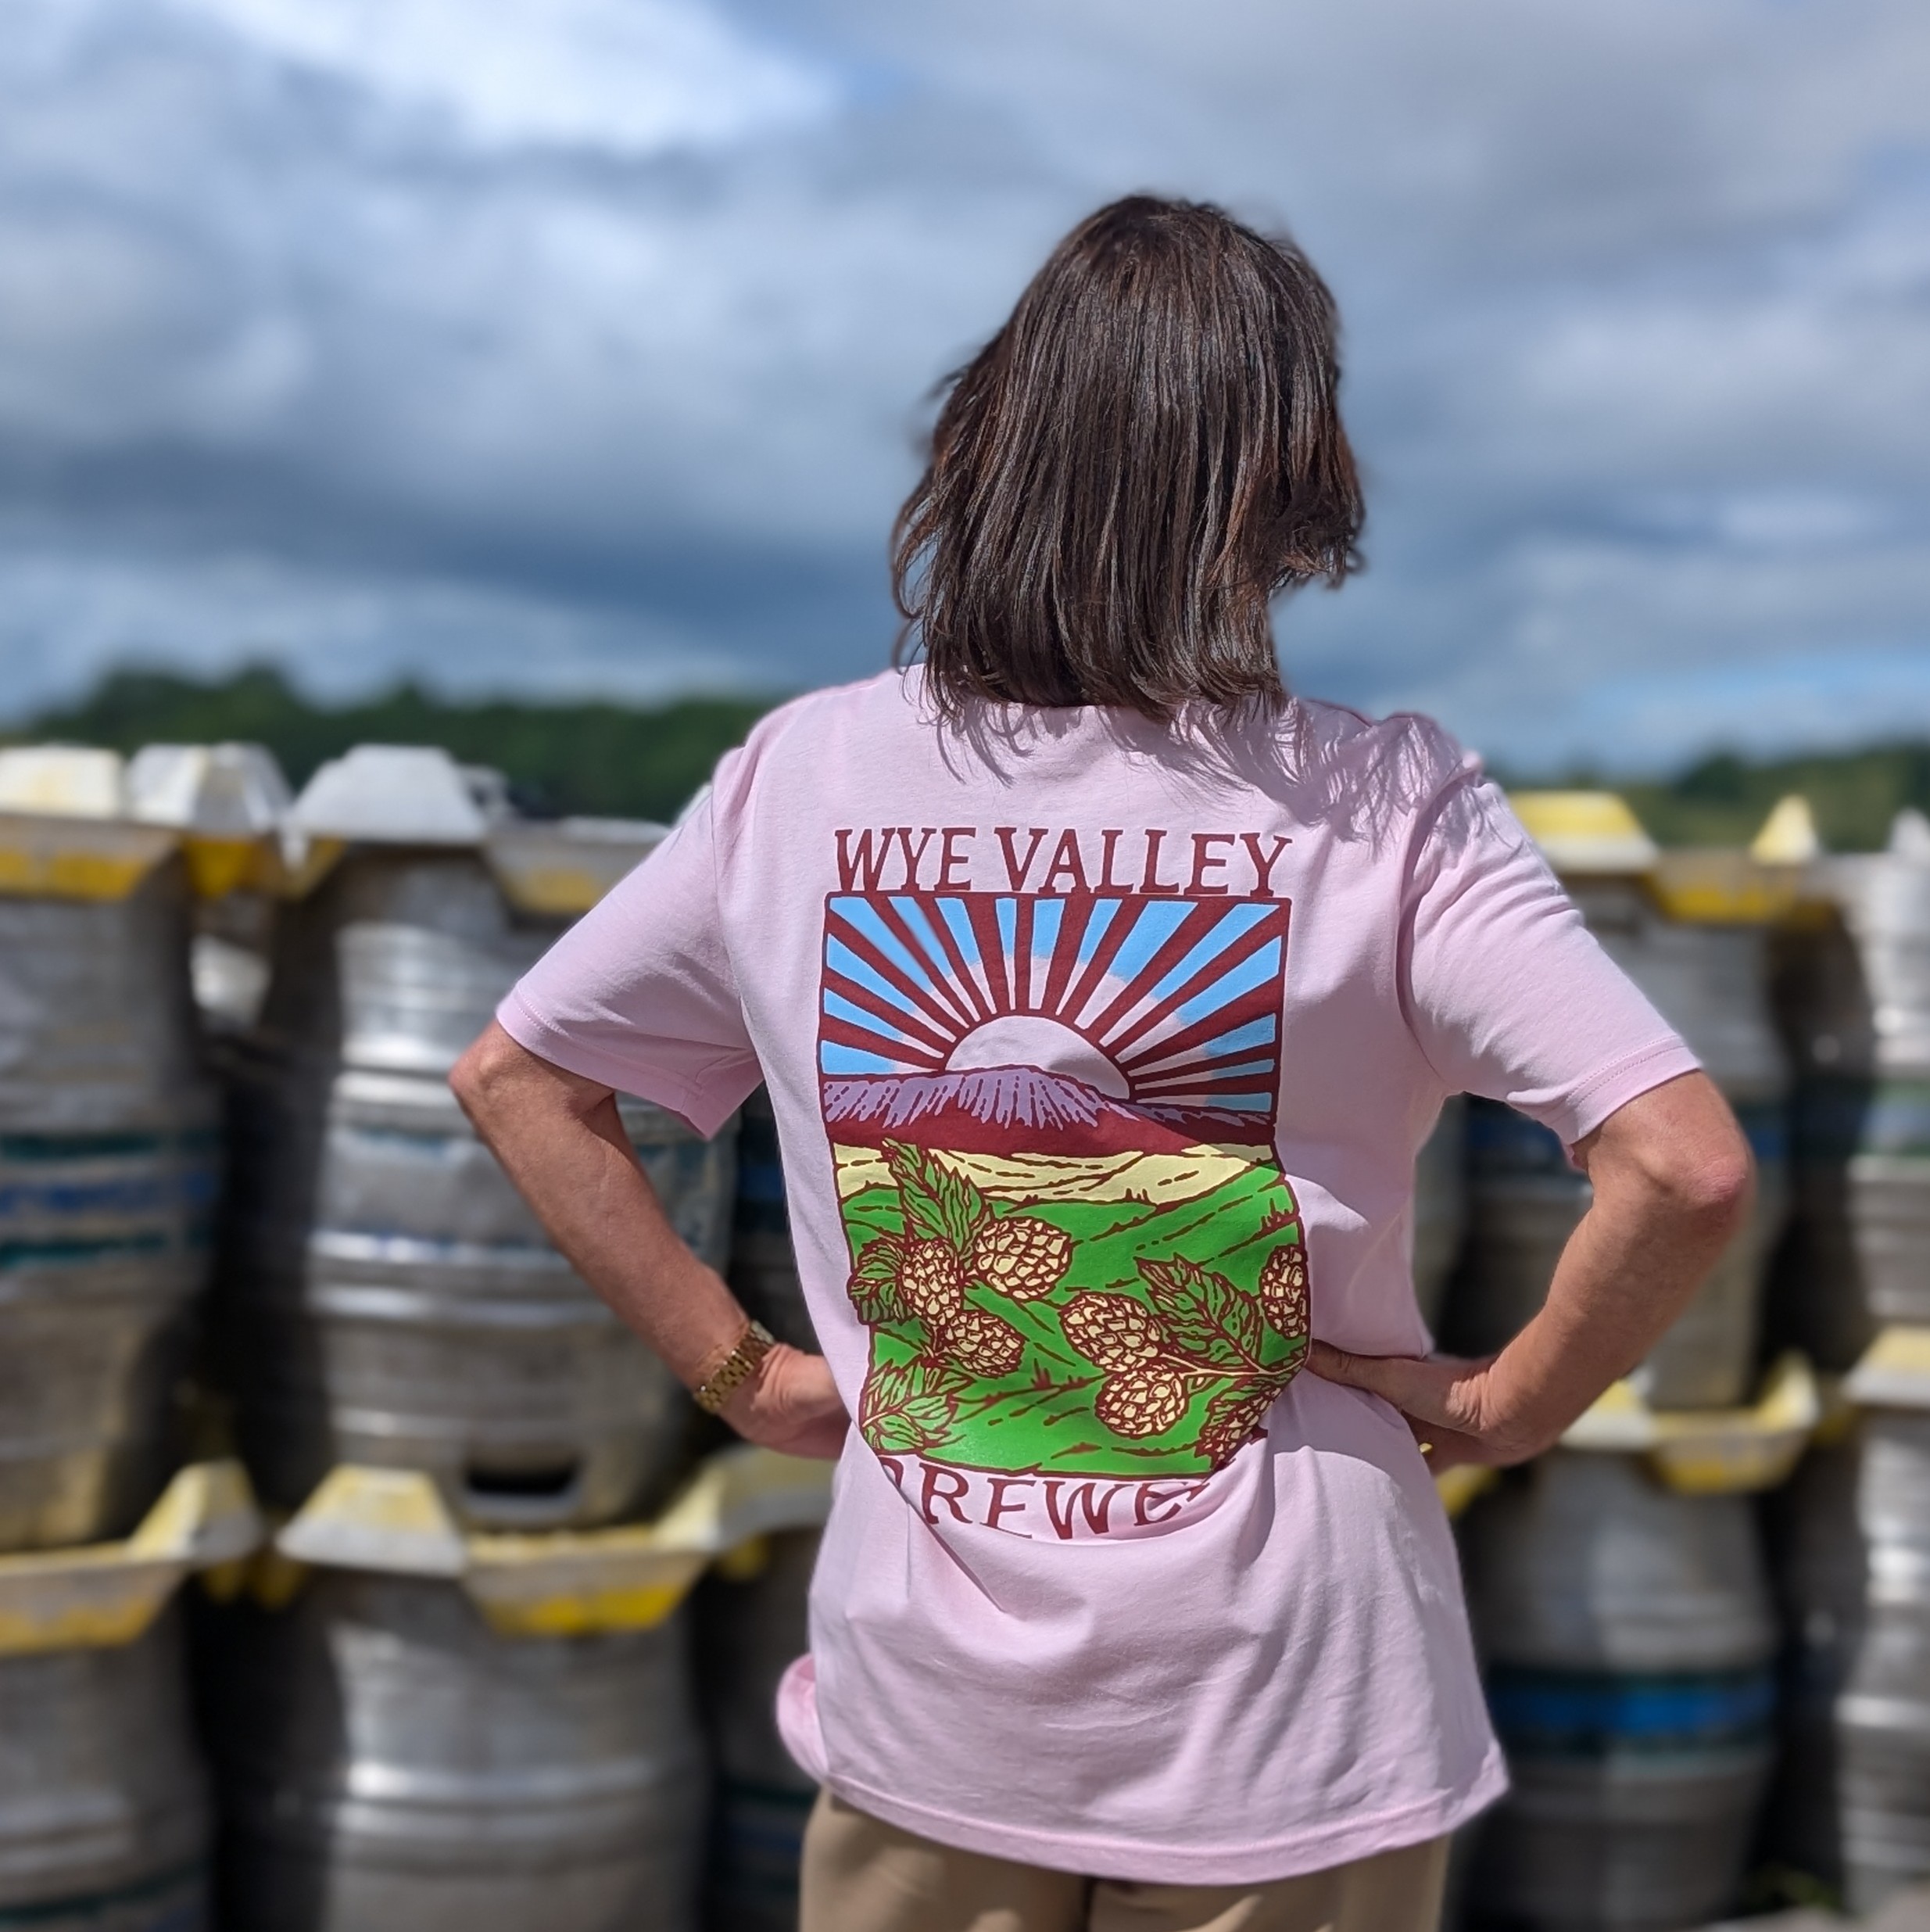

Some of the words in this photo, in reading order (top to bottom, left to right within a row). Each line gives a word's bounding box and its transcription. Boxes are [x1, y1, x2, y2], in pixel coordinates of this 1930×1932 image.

[834, 826, 976, 893] WYE
[994, 826, 1292, 898] VALLEY
[877, 1456, 1210, 1540] REWE
